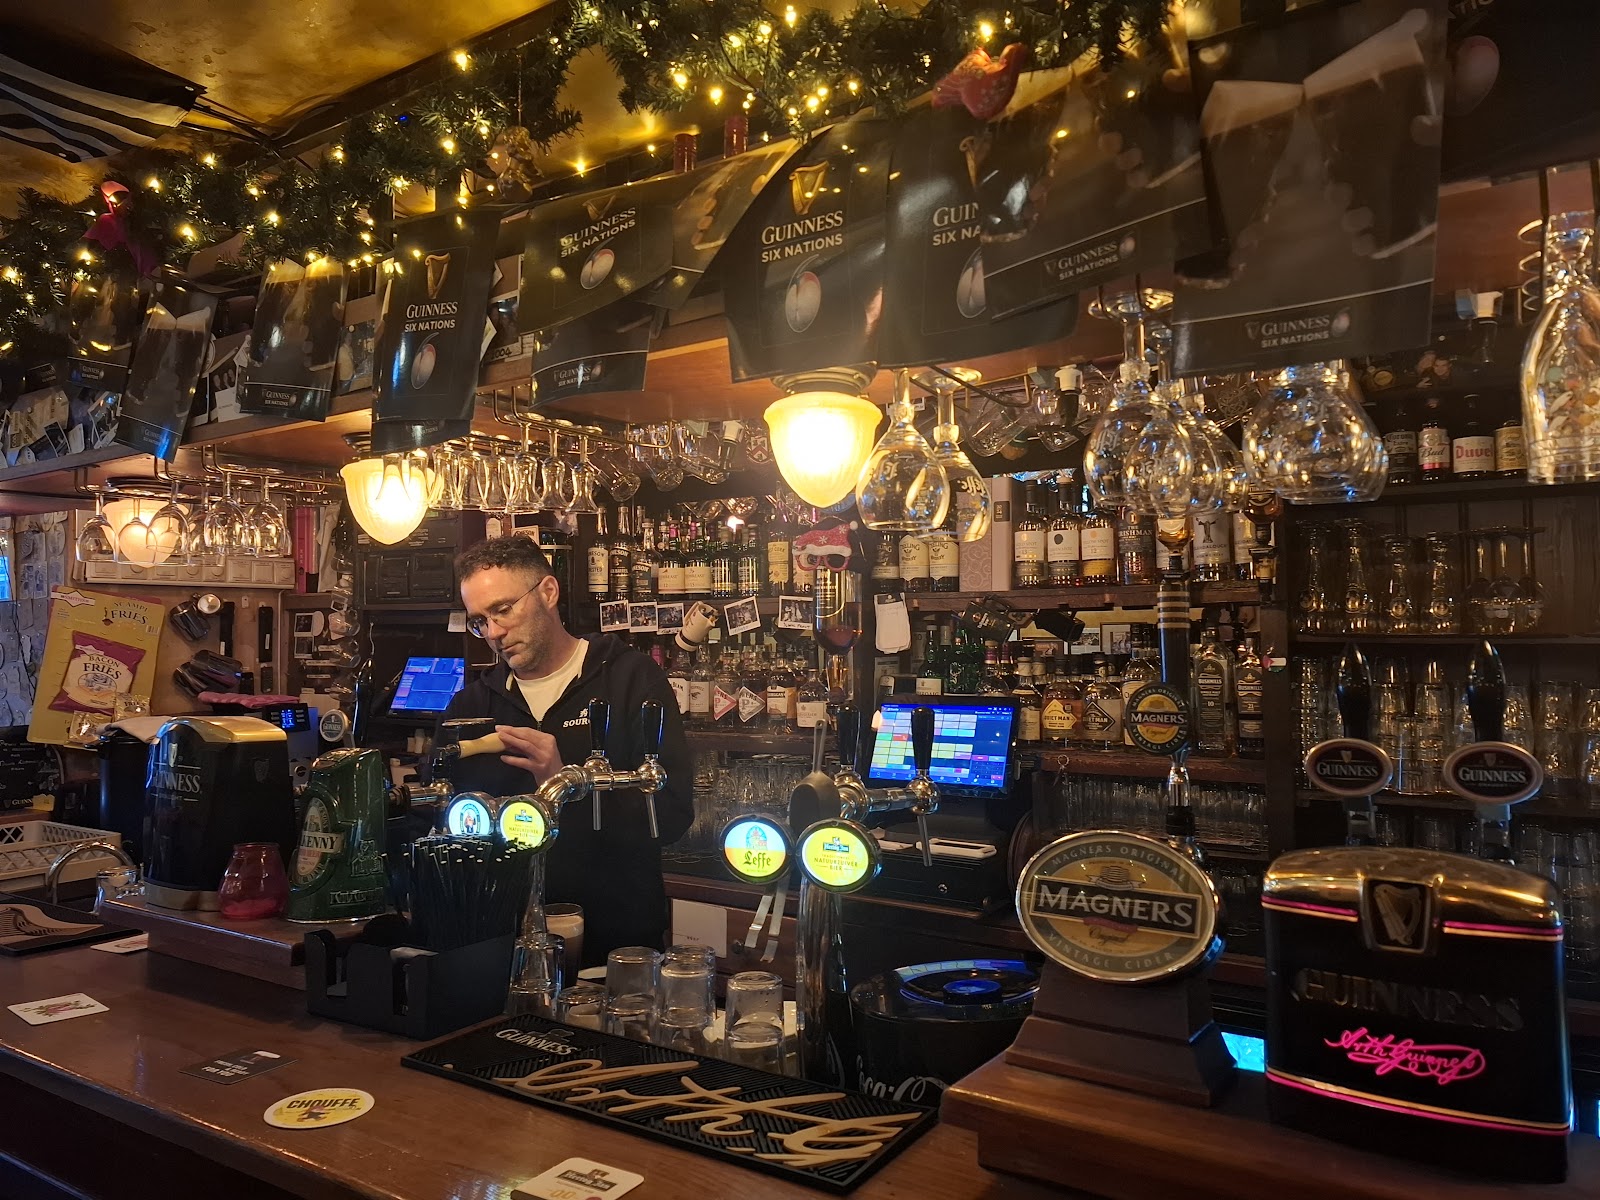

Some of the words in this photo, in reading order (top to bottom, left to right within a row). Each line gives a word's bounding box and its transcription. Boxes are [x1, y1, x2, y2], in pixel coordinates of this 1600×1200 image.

[560, 208, 636, 247] GUINNESS
[762, 211, 843, 245] GUINNESS
[561, 243, 579, 258] SIX
[582, 219, 636, 248] NATIONS
[932, 230, 956, 246] SIX
[762, 247, 781, 263] SIX
[784, 234, 843, 256] NATIONS
[1058, 241, 1118, 270] GUINNESS
[1059, 269, 1074, 281] SIX
[1076, 254, 1118, 275] NATIONS
[406, 302, 457, 319] GUINNESS
[404, 321, 418, 332] SIX
[418, 320, 455, 331] NATIONS
[1261, 315, 1330, 337] GUINNESS
[1262, 336, 1279, 348] SIX
[1280, 331, 1329, 346] NATIONS
[266, 391, 290, 400] GUINNESS
[1421, 447, 1445, 458] Bud
[1455, 445, 1494, 459] Duvel
[113, 602, 148, 613] SCAMPI
[111, 610, 149, 625] FRIES
[89, 654, 121, 668] BACON
[83, 662, 122, 680] FRIES
[1130, 712, 1185, 724] MAGNERS
[1133, 728, 1162, 750] VINTAGE
[1166, 730, 1188, 749] CIDER
[1316, 761, 1379, 778] GUINNESS
[1458, 767, 1527, 784] GUINNESS
[743, 850, 771, 869] Leffe
[814, 857, 858, 867] NATUURZUIVER
[1051, 844, 1112, 866] MAGNERS
[1119, 846, 1187, 883] ORIGINAL
[1038, 884, 1193, 927] MAGNERS
[1049, 933, 1110, 968] VINTAGE
[1124, 952, 1175, 969] CIDER
[1291, 967, 1525, 1032] GUINNESS
[495, 1027, 578, 1057] GUINNESS
[286, 1097, 362, 1110] CHOUFFE
